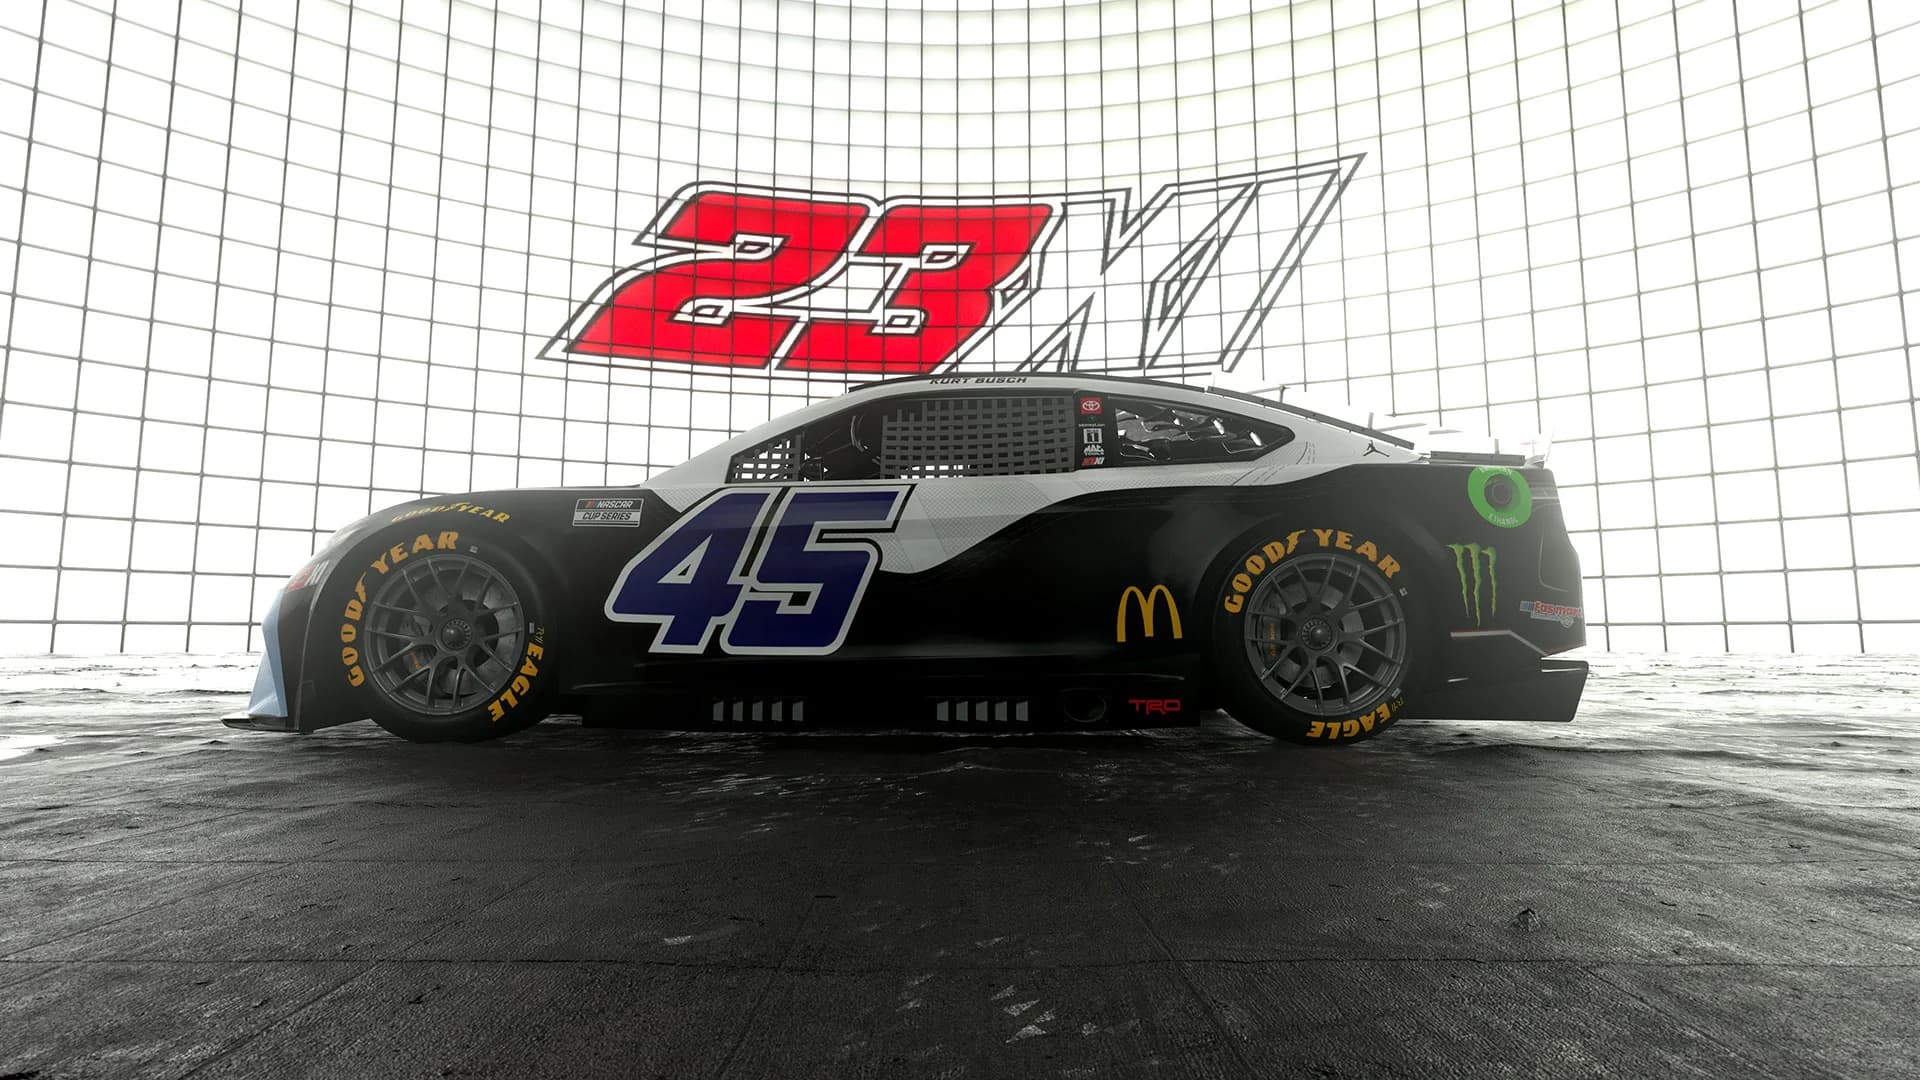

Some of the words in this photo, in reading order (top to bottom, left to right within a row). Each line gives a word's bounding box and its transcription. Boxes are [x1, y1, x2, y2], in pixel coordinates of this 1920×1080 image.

[929, 377, 970, 385] KURT
[974, 376, 1027, 384] BUSCH
[596, 500, 634, 510] NASCAR
[582, 512, 600, 521] CUP
[600, 512, 632, 521] SERIES
[603, 485, 917, 657] 45
[488, 642, 544, 722] EAGLE
[1128, 699, 1181, 715] TRD
[1306, 703, 1392, 739] EAGLE
